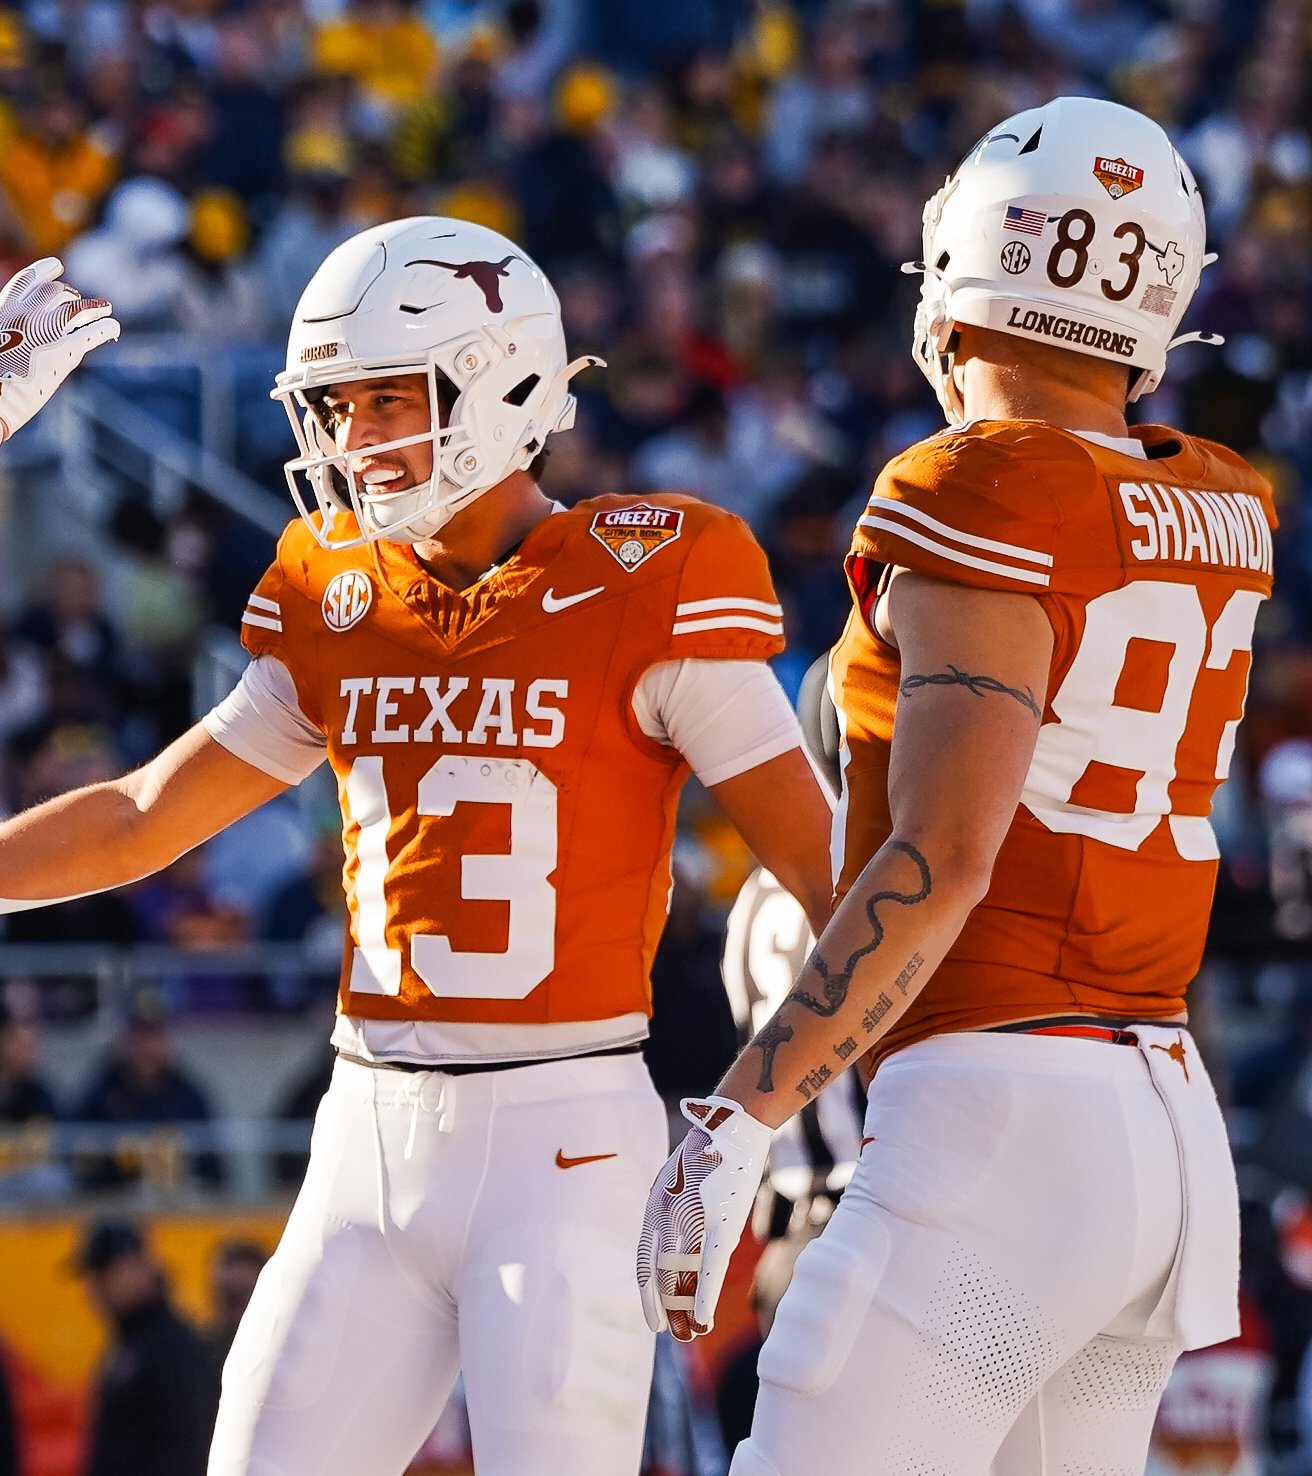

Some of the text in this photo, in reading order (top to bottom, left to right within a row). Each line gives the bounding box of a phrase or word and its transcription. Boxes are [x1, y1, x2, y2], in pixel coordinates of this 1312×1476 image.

[1001, 241, 1030, 273] SEC
[1046, 208, 1146, 302] 83
[300, 342, 338, 363] HORNS
[1007, 307, 1137, 357] LONGHORNS
[604, 528, 636, 538] CITRUS
[1118, 482, 1274, 576] SHANNON
[326, 573, 368, 627] SEC
[340, 676, 569, 748] TEXAS
[348, 754, 558, 1000] 13
